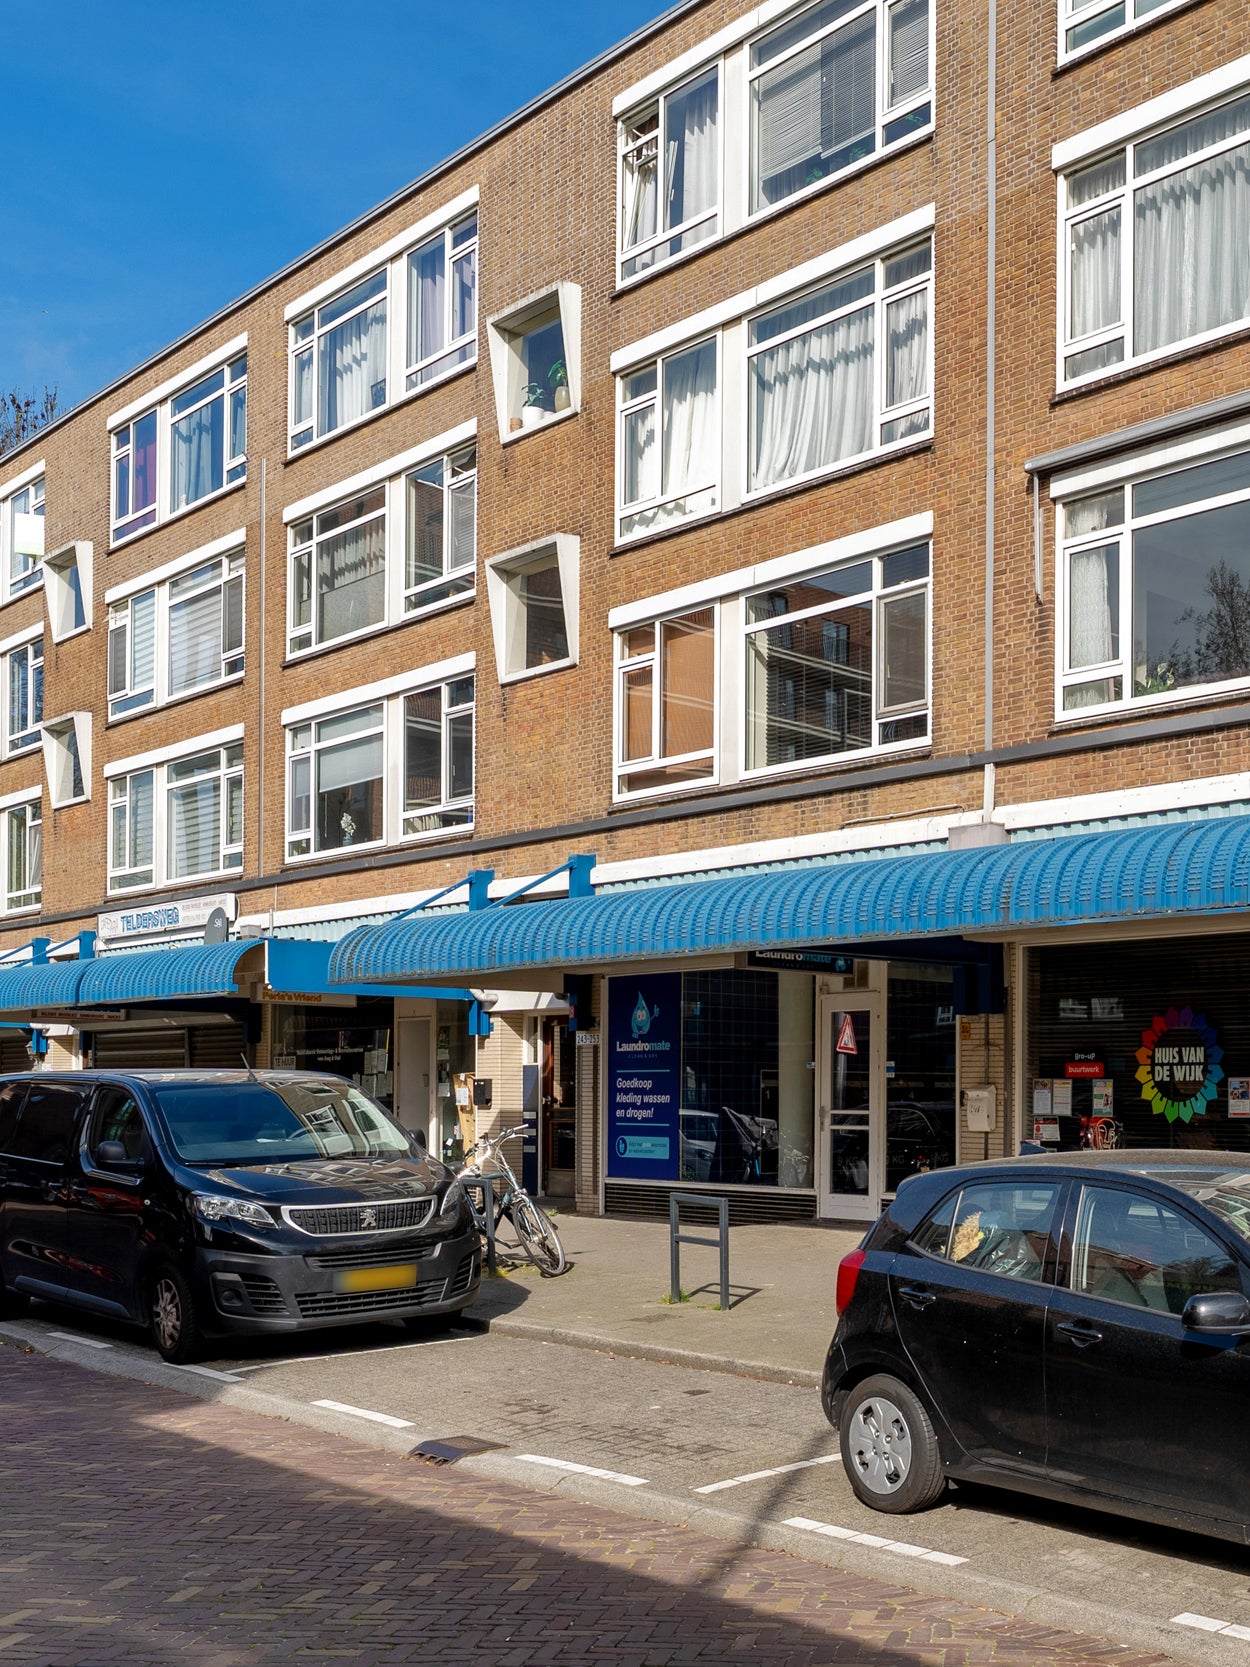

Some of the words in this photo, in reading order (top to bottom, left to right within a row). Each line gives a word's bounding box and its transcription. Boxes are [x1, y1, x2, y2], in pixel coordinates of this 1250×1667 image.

[120, 907, 180, 932] TELDERSWEG
[616, 1041, 671, 1052] Laundromate
[1155, 1047, 1179, 1063] HUIS
[1182, 1047, 1204, 1063] VAN
[1155, 1065, 1170, 1081] DE
[1173, 1065, 1204, 1081] WIJK
[616, 1078, 653, 1090] Goedkoop
[616, 1093, 642, 1105] kleding
[643, 1095, 670, 1103] wassen
[616, 1108, 625, 1117] en
[626, 1107, 654, 1120] drogen!
